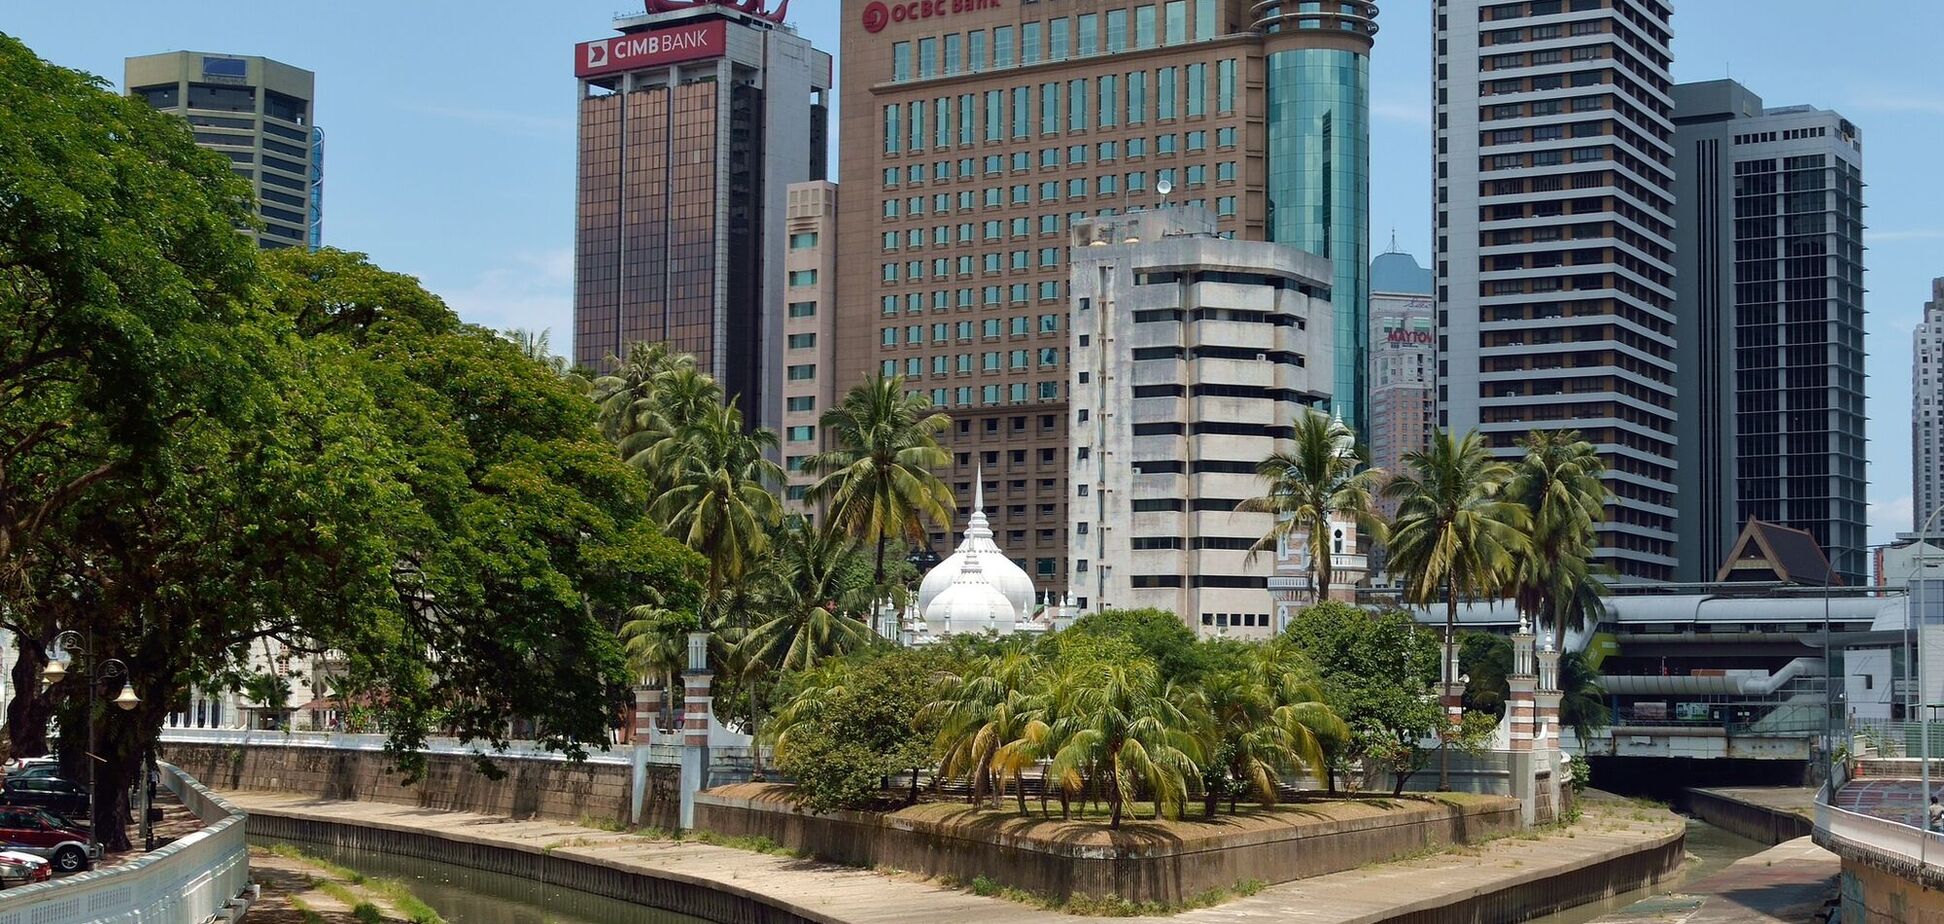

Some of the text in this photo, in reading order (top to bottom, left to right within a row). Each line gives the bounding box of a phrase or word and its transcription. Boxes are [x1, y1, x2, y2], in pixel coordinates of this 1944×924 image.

[891, 0, 946, 22] OCBC
[615, 29, 707, 58] CIMB BANK
